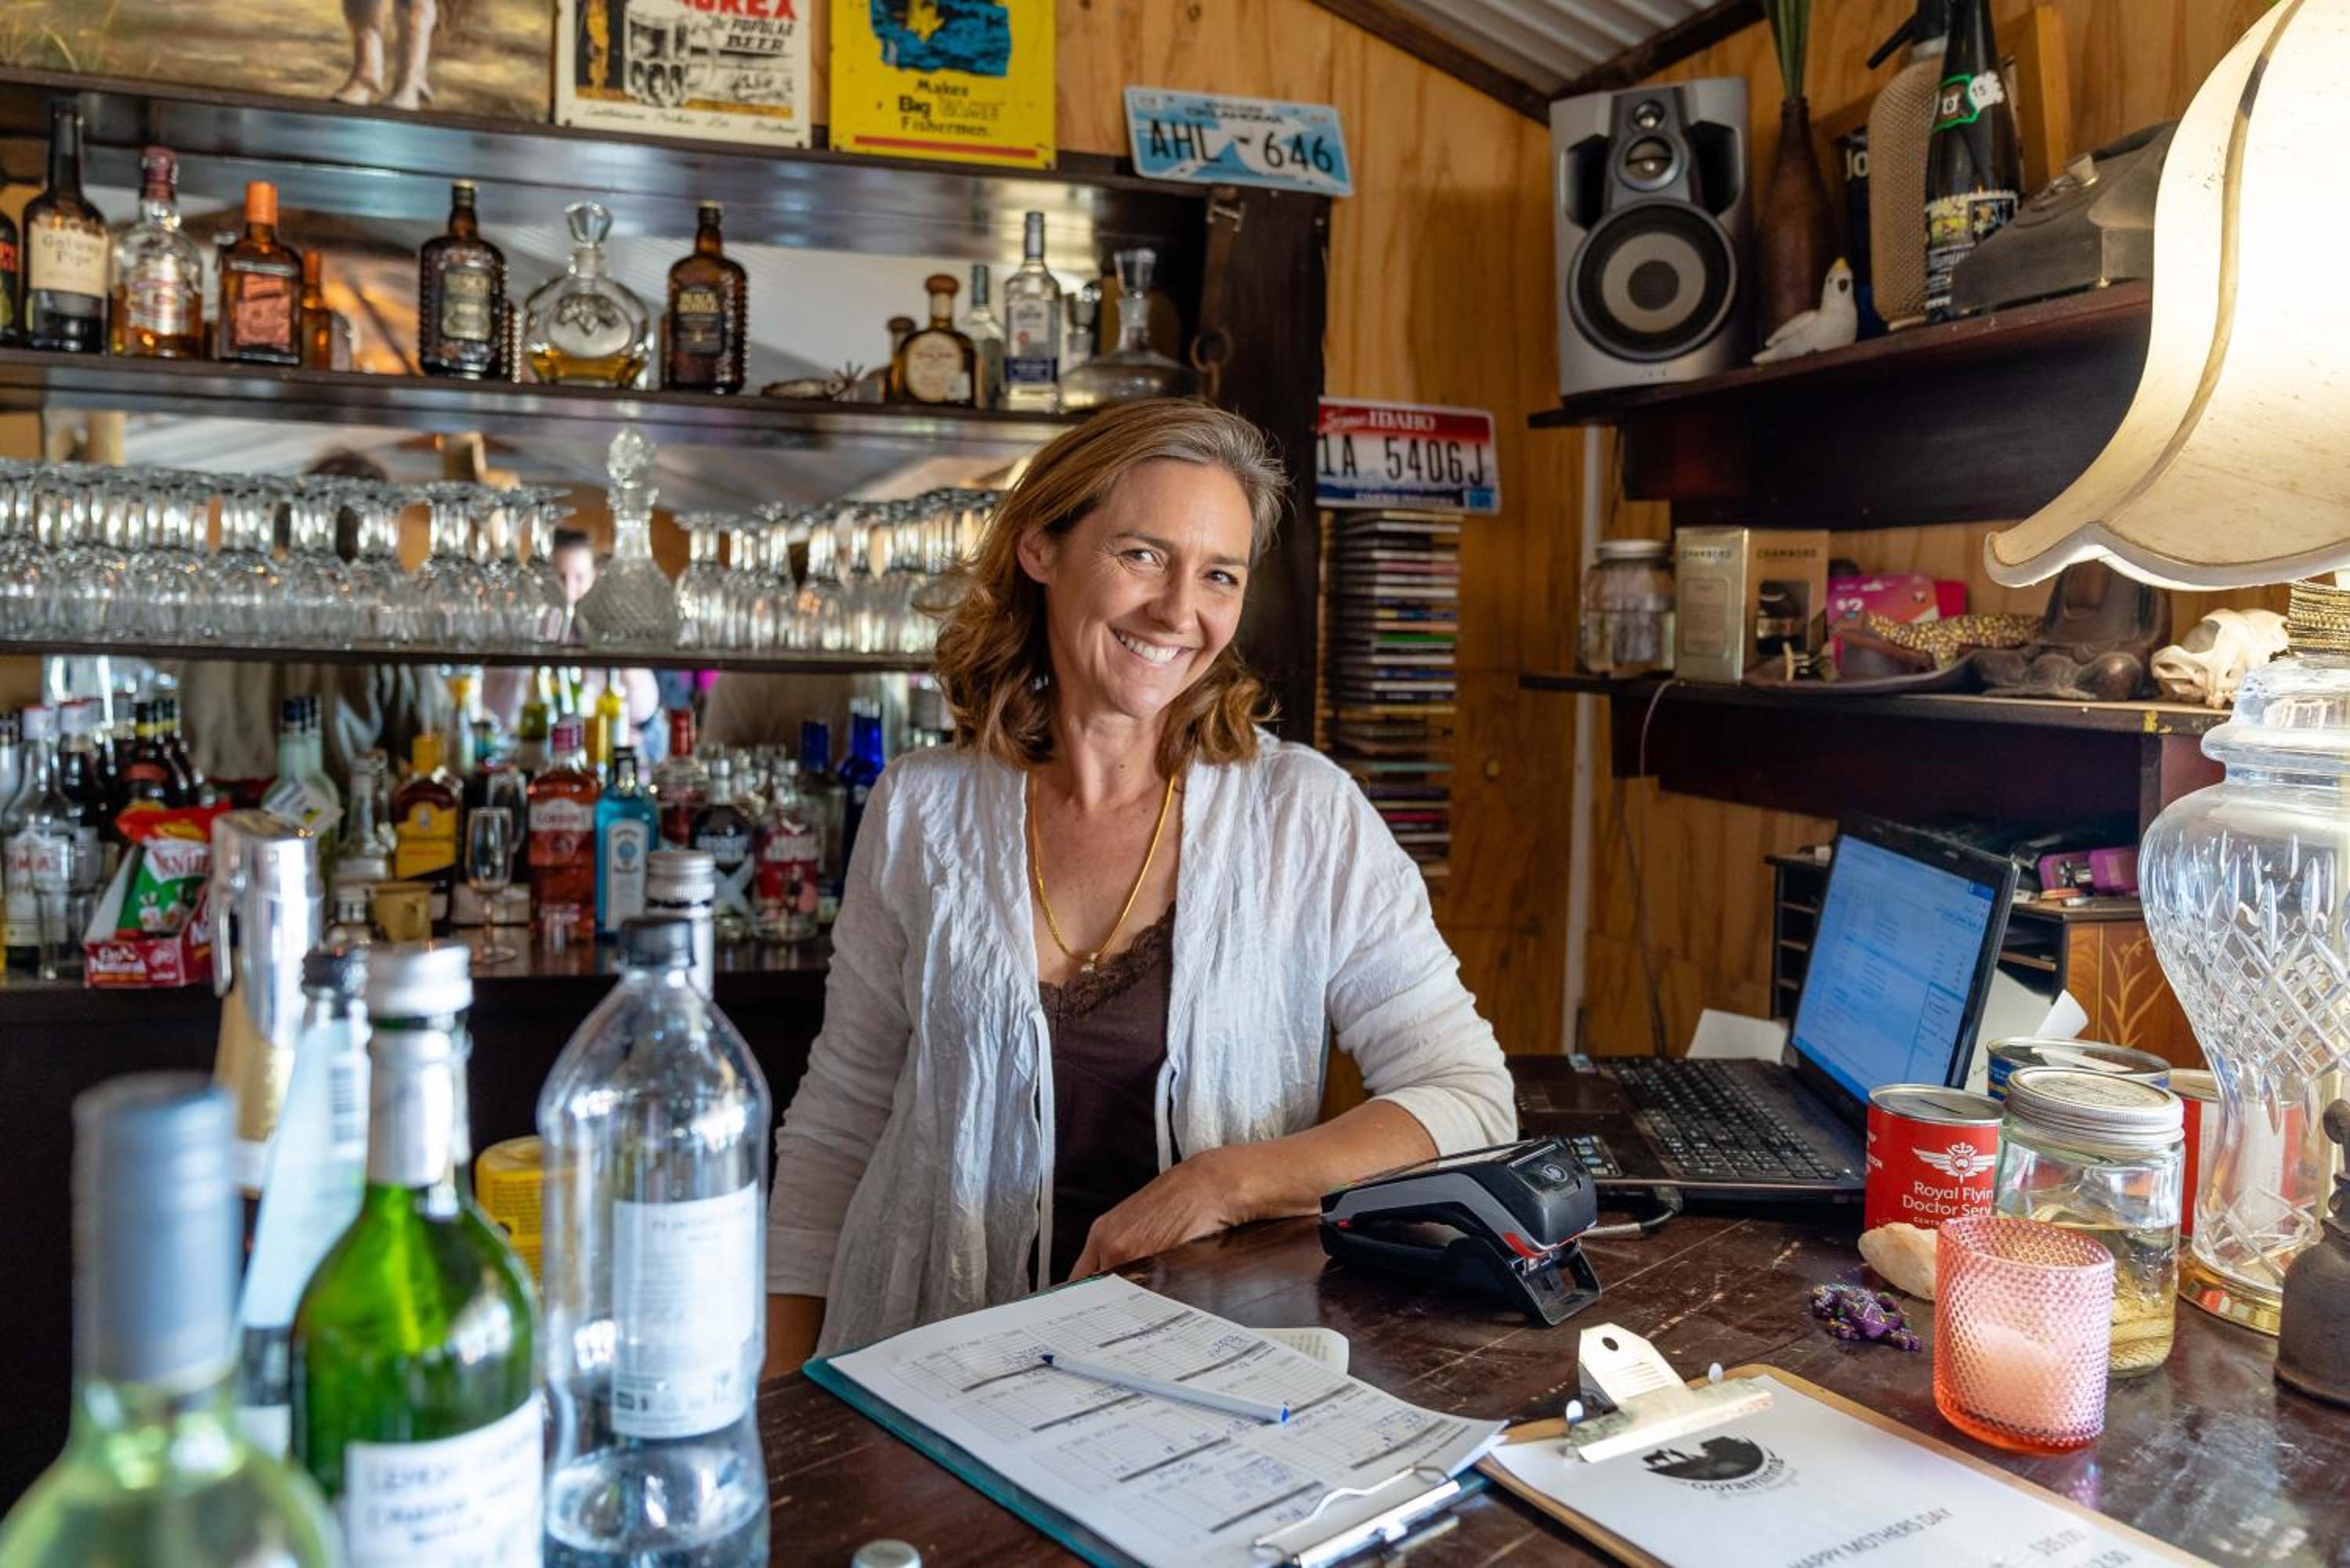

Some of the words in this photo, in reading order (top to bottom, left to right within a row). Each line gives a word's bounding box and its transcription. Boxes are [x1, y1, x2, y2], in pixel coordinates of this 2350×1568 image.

[726, 34, 785, 51] BEER
[915, 79, 969, 97] Makes
[1368, 410, 1437, 431] IDAHO
[1383, 435, 1486, 488] 5406J
[1913, 1180, 1958, 1201] Royal
[1962, 1187, 1994, 1204] Flyin
[1902, 1194, 1958, 1216] Doctor
[1961, 1204, 1992, 1217] Serv
[1841, 1519, 1925, 1553] MOTHERS
[1918, 1507, 1957, 1527] DAY
